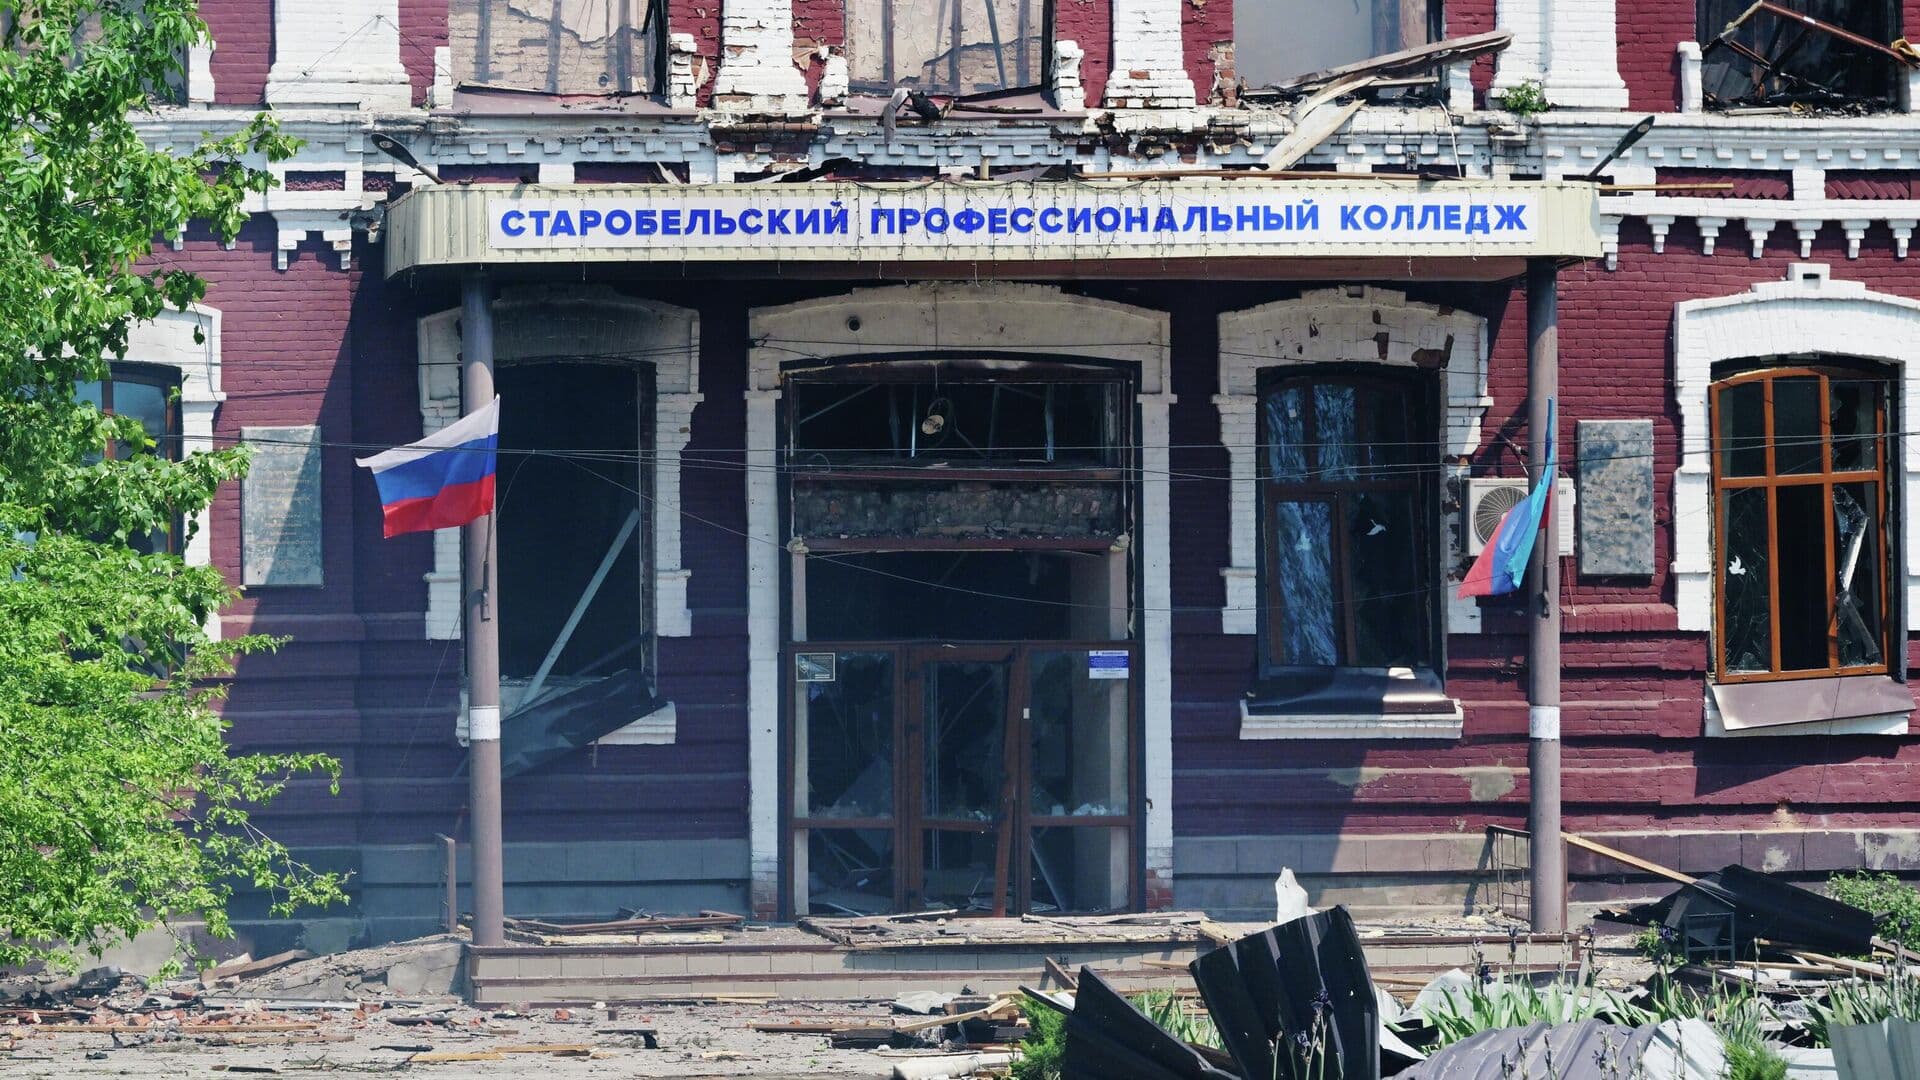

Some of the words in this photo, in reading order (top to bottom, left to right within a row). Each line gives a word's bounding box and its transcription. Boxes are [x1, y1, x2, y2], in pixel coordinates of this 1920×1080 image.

[500, 200, 848, 236] СТАРОБЕЛЬСКИЙ
[871, 199, 1318, 234] ПРОФЕССИОНАЛЬНЫЙ
[1340, 204, 1527, 234] КОЛЛЕДЖ
